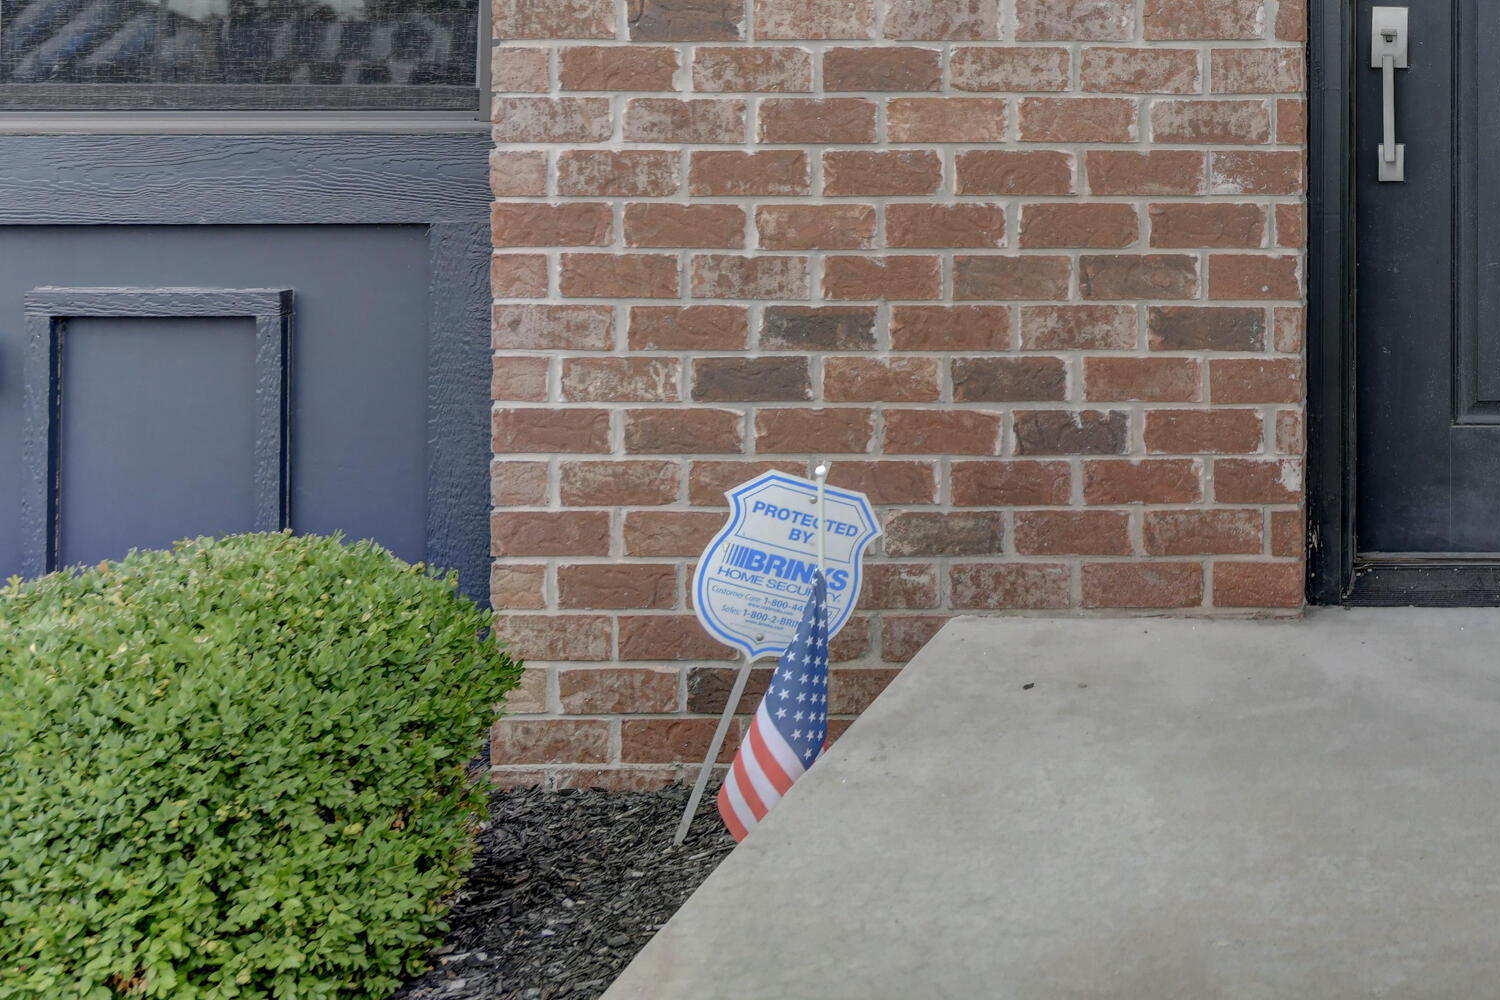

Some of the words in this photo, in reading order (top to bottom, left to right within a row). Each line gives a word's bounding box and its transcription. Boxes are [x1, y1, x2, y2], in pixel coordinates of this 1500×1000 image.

[788, 528, 814, 544] BY
[717, 566, 764, 587] HOME
[711, 585, 745, 599] Customer
